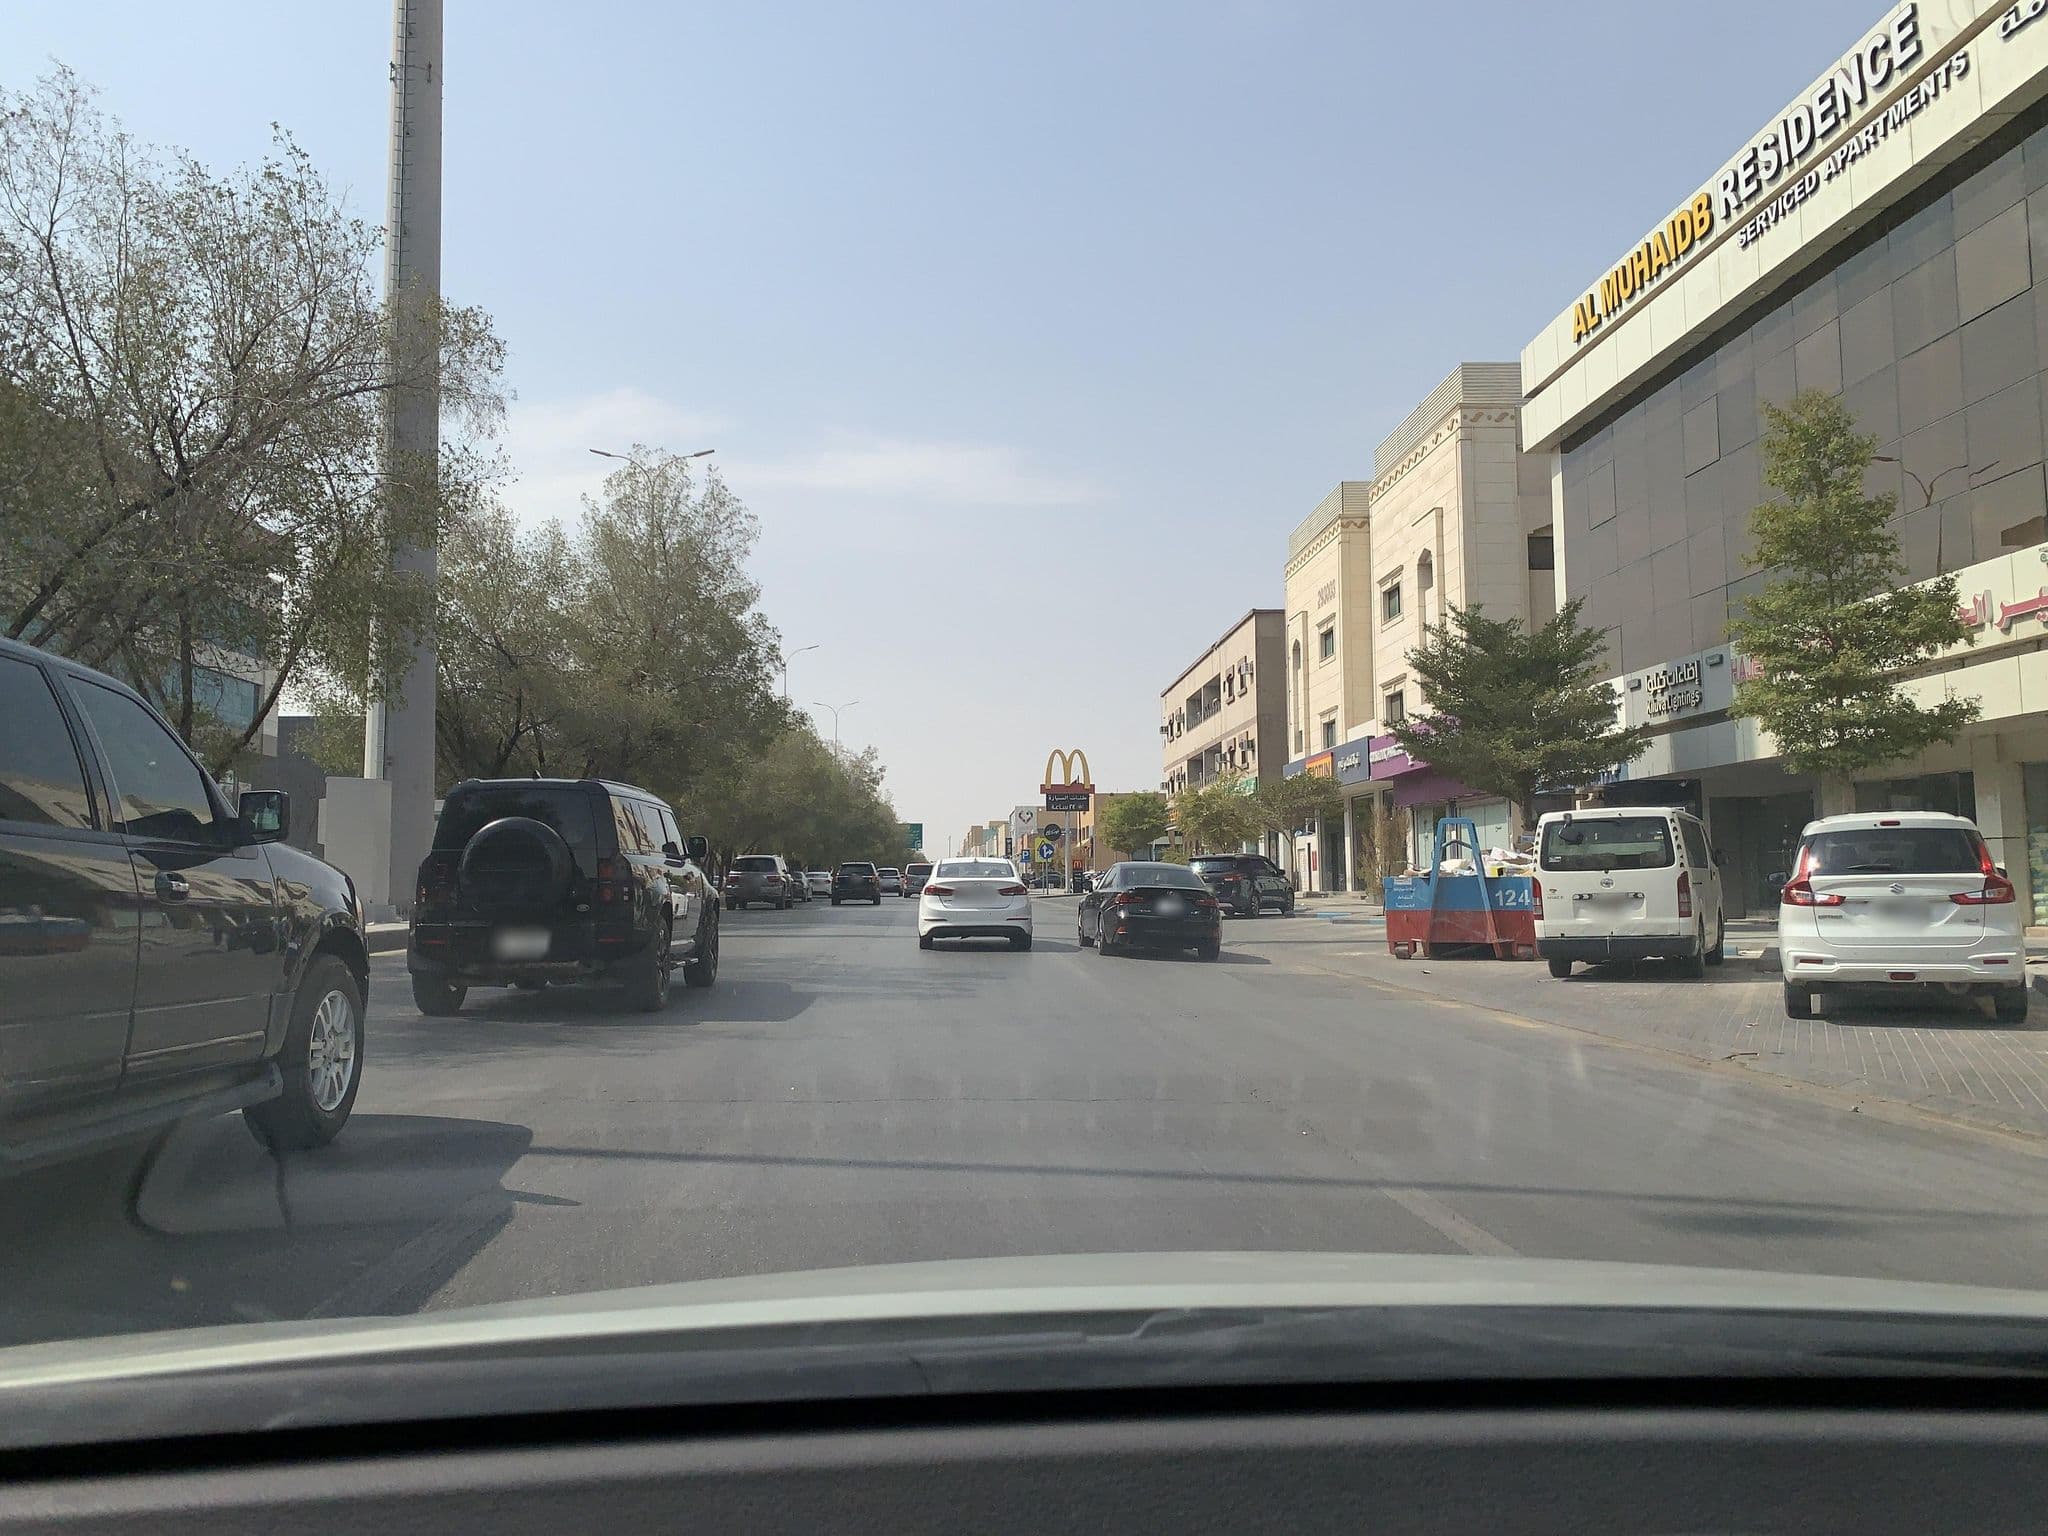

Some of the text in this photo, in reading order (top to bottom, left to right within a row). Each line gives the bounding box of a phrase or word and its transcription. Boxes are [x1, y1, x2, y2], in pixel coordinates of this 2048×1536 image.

[1737, 51, 1970, 248] SERVICED APARTMENTS
[1572, 3, 1921, 343] AL MUHAIDB RESIDENCE
[1667, 690, 1700, 712] Lightings
[1022, 850, 1029, 859] P
[1495, 889, 1531, 906] 124
